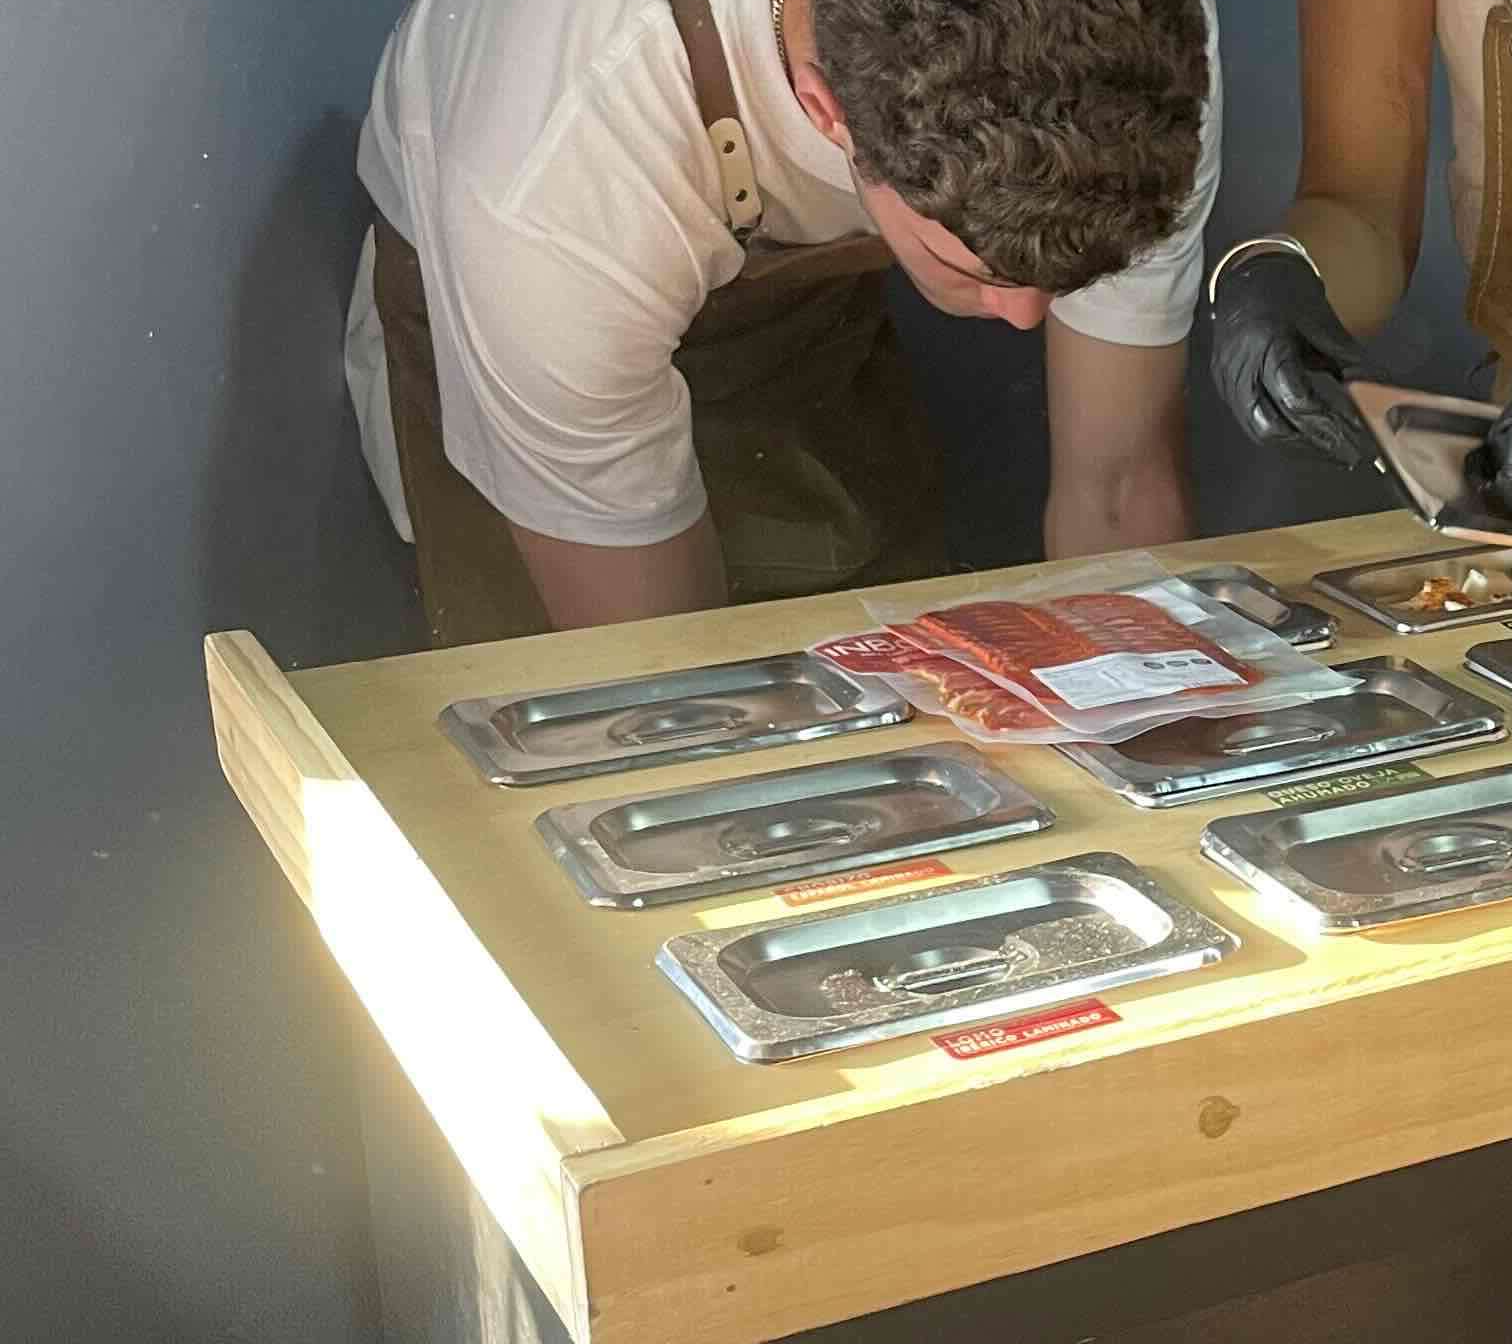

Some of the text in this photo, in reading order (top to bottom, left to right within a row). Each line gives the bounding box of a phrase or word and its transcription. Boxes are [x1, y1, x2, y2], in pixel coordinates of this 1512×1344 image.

[1279, 780, 1371, 805] AHUMADO
[944, 1028, 1005, 1048] LOMO
[1023, 1012, 1102, 1039] LAMINADO
